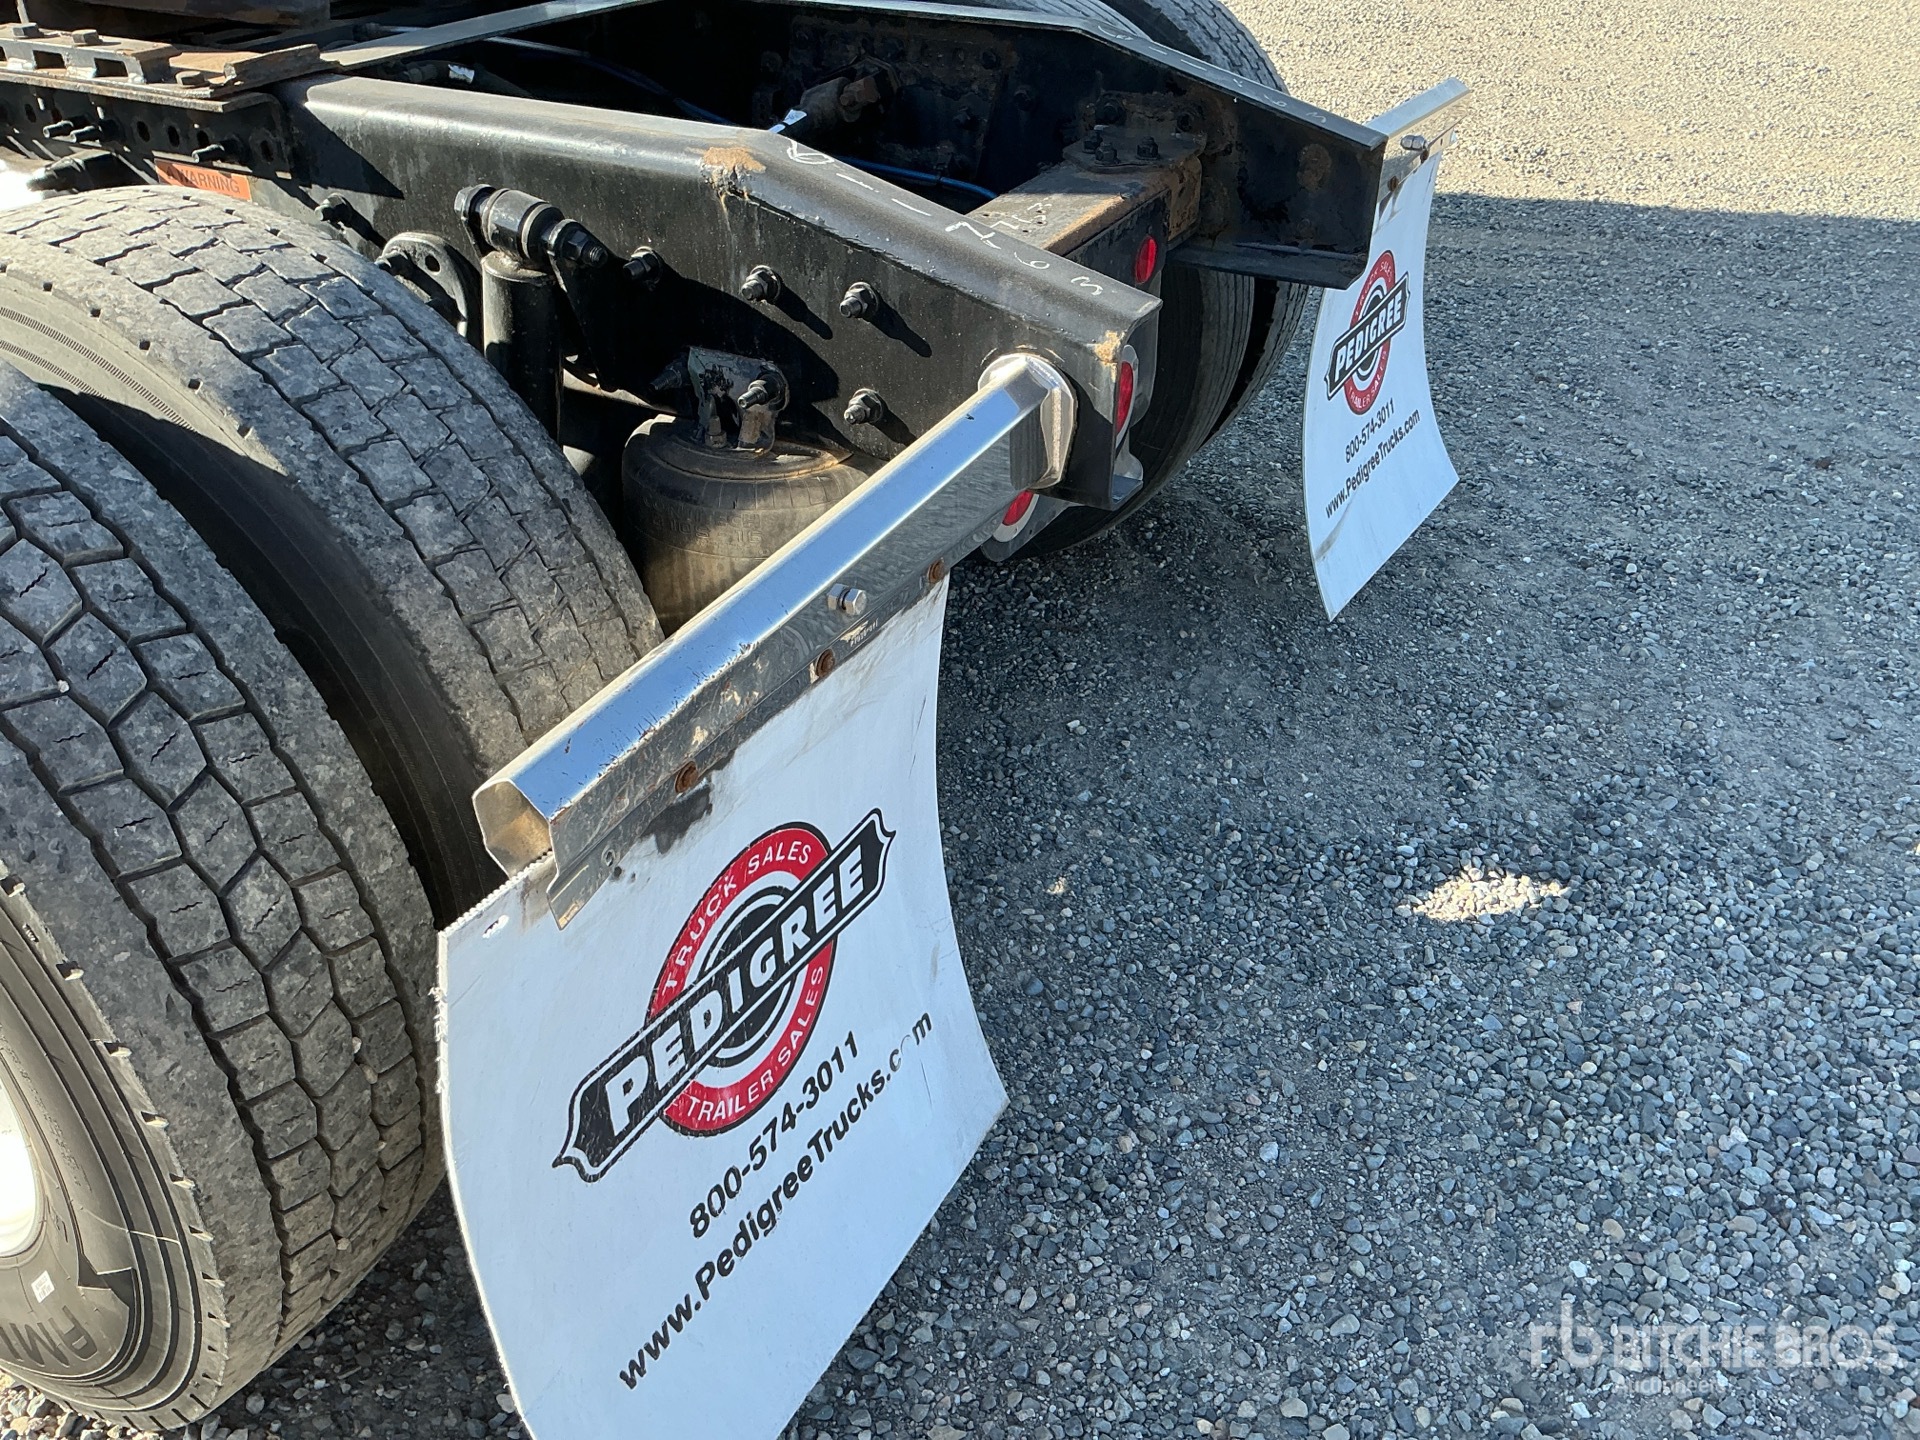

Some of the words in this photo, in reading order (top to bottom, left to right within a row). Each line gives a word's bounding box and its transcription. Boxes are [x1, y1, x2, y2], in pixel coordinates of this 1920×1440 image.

[180, 168, 241, 195] WARNING
[1334, 290, 1403, 383] PEDIGREE
[1345, 397, 1395, 464] 800-574-3011
[1348, 386, 1371, 410] TRAILER
[1325, 409, 1421, 519] www.PedigreeTrucks.com
[662, 875, 738, 997] TRUCK
[748, 841, 812, 876] SALES
[604, 845, 865, 1139] PEDIGREE
[686, 1070, 776, 1123] TRAILER
[777, 965, 825, 1069] SALES
[689, 1030, 860, 1239] 800-574-3011
